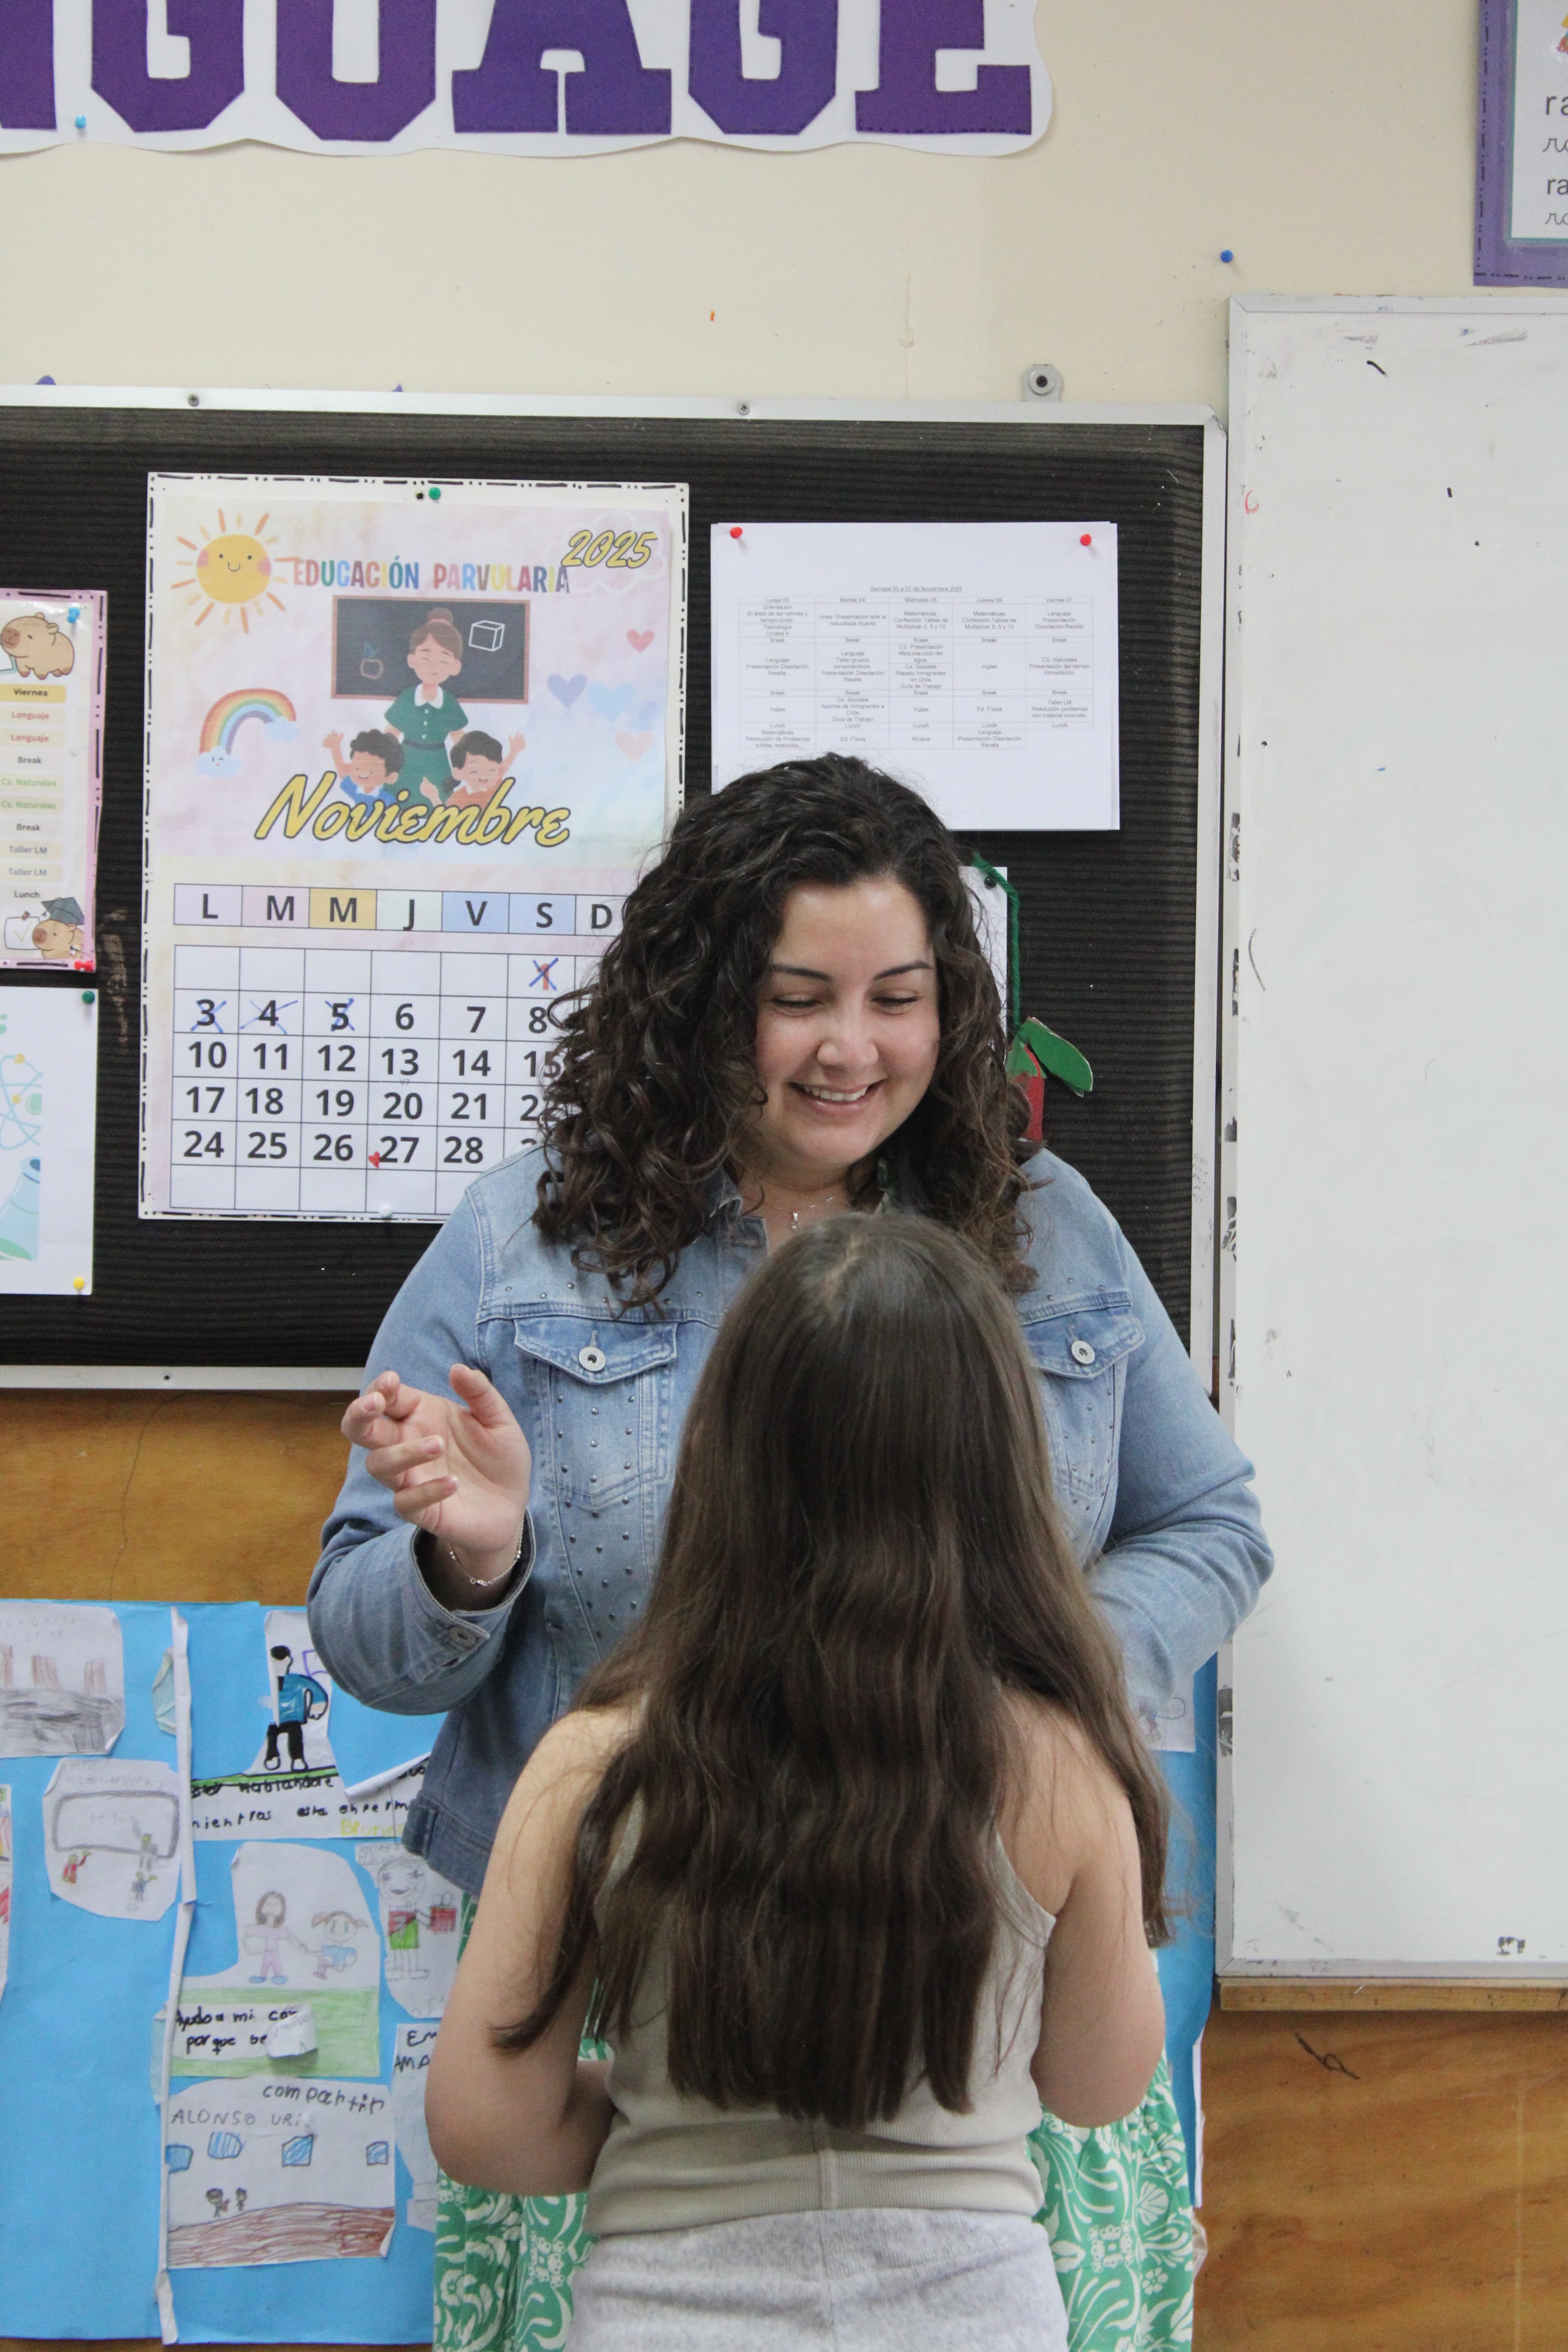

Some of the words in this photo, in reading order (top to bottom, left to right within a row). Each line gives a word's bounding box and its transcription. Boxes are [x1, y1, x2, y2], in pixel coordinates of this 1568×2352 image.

[561, 529, 658, 569] 2025
[293, 556, 419, 590] EDUCACIÓN
[433, 563, 570, 593] PARVULARIA
[14, 688, 49, 696] Viernes
[11, 710, 49, 721] Lenguaje
[11, 734, 49, 743] Lenguaje
[17, 756, 42, 764] Break
[16, 778, 57, 787] Naturales
[16, 801, 57, 809] Naturales
[254, 772, 570, 848] Noviembre
[9, 845, 33, 853] Taller
[8, 868, 32, 876] Taller
[14, 890, 40, 898] Lunch
[203, 894, 218, 919] L
[267, 895, 294, 921] M
[330, 897, 356, 922] M
[403, 900, 414, 931] J
[466, 901, 487, 926] V
[537, 903, 552, 928] S
[591, 904, 612, 929] D
[197, 999, 215, 1026] 3
[258, 1000, 278, 1026] 4
[332, 1003, 349, 1030] 5
[396, 1003, 414, 1030] 6
[467, 1007, 486, 1033] 7
[529, 1007, 547, 1033] 8
[189, 1042, 226, 1068] 10
[254, 1043, 287, 1070] 11
[318, 1045, 355, 1071] 12
[382, 1049, 419, 1075] 13
[453, 1050, 490, 1076] 14
[523, 1050, 561, 1078] 15
[187, 1087, 225, 1113] 17
[246, 1088, 283, 1114] 18
[316, 1090, 354, 1116] 19
[383, 1092, 422, 1120] 20
[451, 1093, 486, 1120] 21
[184, 1131, 224, 1158] 24
[248, 1132, 287, 1159] 25
[314, 1134, 353, 1161] 26
[379, 1136, 419, 1163] 27
[444, 1136, 483, 1164] 28
[171, 2109, 256, 2125] ALONSO
